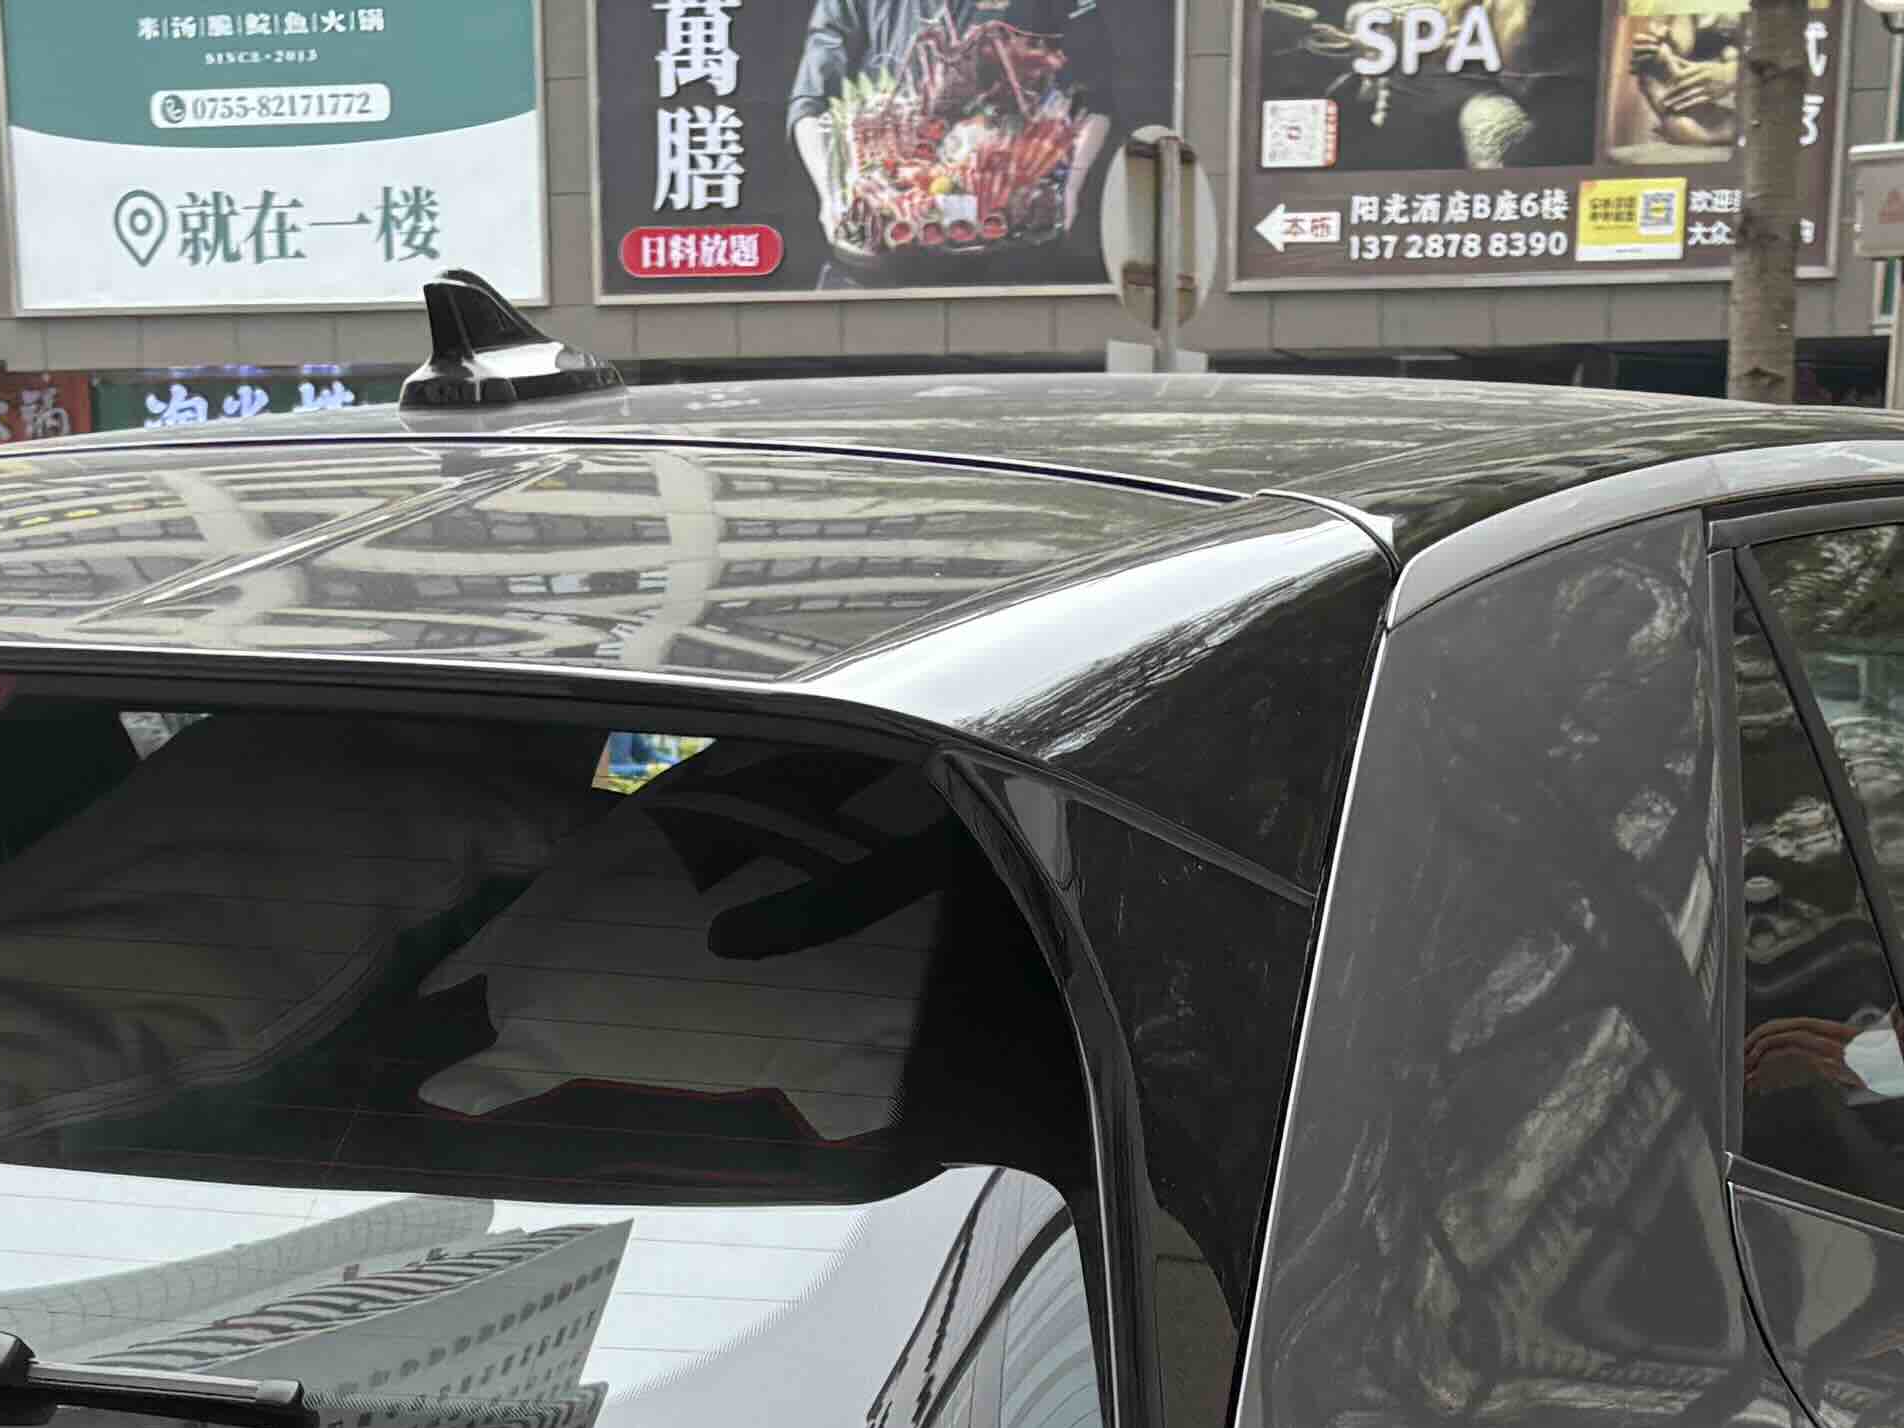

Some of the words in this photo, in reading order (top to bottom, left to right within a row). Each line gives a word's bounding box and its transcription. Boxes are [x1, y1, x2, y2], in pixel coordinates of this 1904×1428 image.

[1352, 6, 1501, 76] SPA
[192, 92, 372, 120] 0755-82171772
[1350, 189, 1569, 225] 阳光酒店B座6楼
[176, 186, 441, 266] 就在一楼
[640, 234, 760, 269] 日料放題
[1349, 235, 1396, 260] 137
[1404, 233, 1482, 259] 2878
[1488, 231, 1568, 258] 8390
